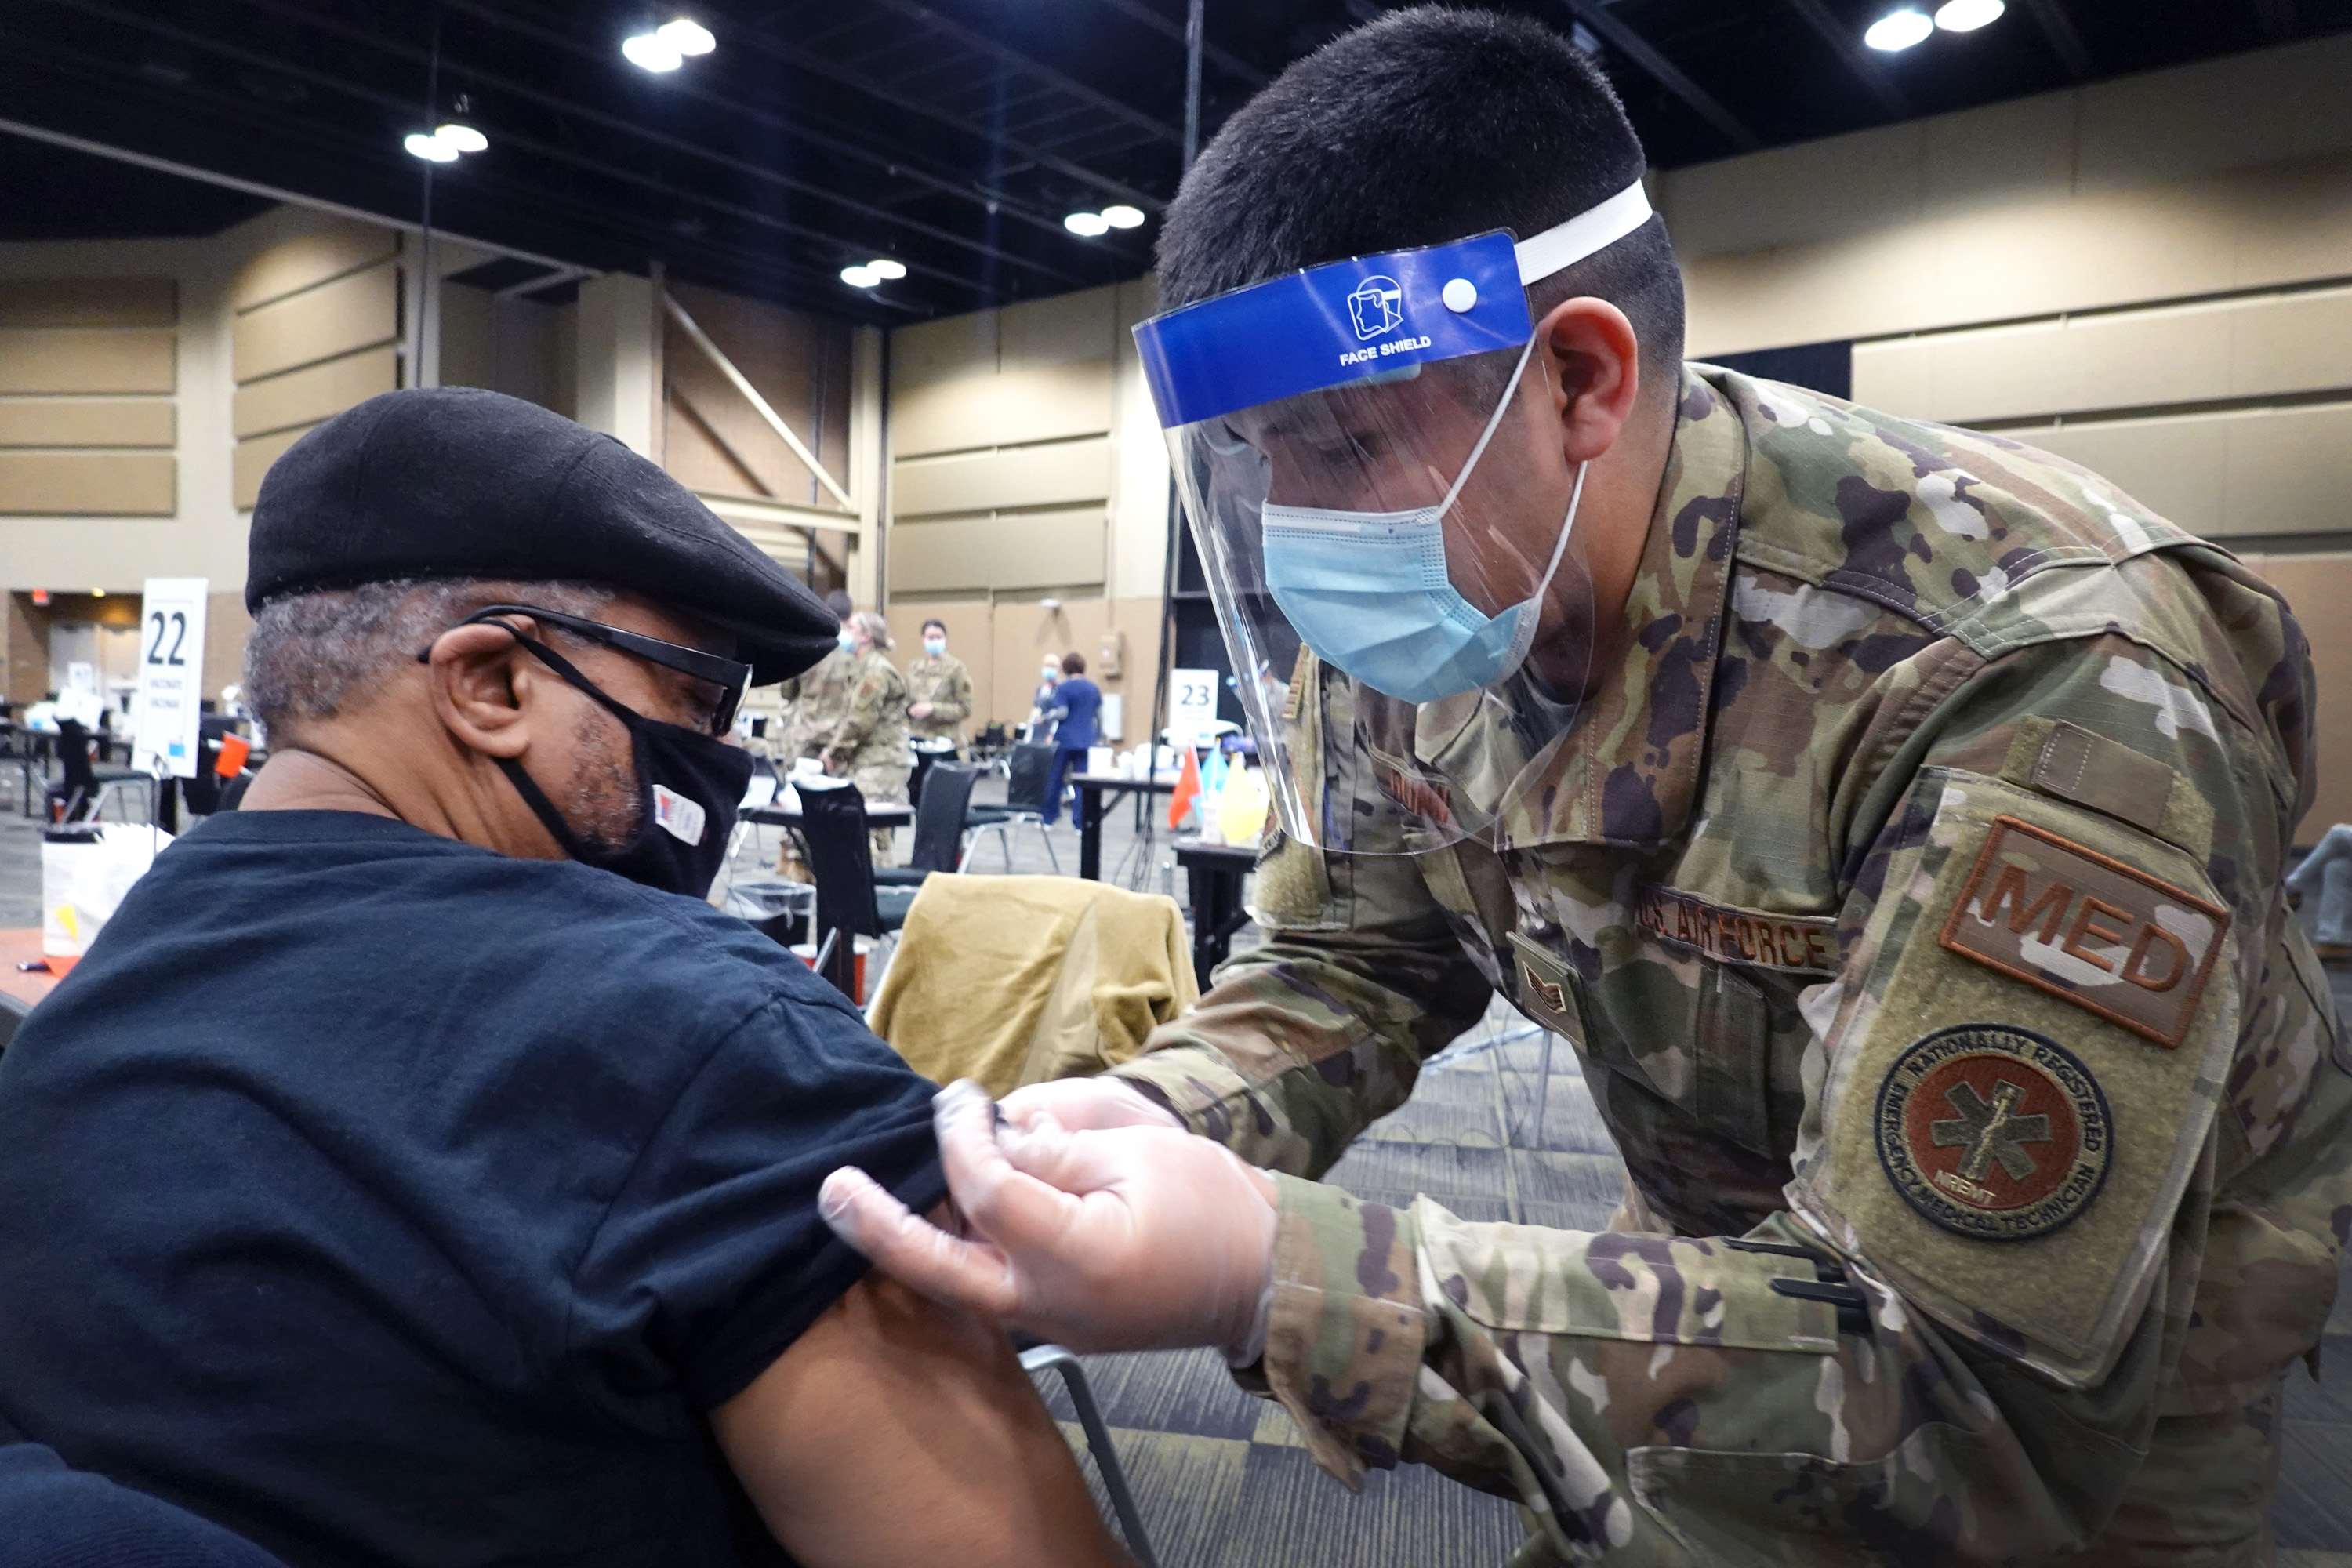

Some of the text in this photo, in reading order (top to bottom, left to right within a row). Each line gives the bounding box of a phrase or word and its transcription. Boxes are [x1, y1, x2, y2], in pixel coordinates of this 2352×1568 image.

[1339, 336, 1432, 366] FACE SHIELD
[147, 610, 187, 666] 22
[1181, 684, 1210, 706] 23
[1677, 902, 1712, 952] AIR
[1717, 913, 1828, 969] FORCE
[1981, 863, 2187, 993] MED
[1907, 1031, 2103, 1151] NATIONALLY REGISTERED
[1885, 1082, 2095, 1231] EMERGENCY MEDICAL TECHNICIAN
[1933, 1168, 1997, 1205] NREMT
